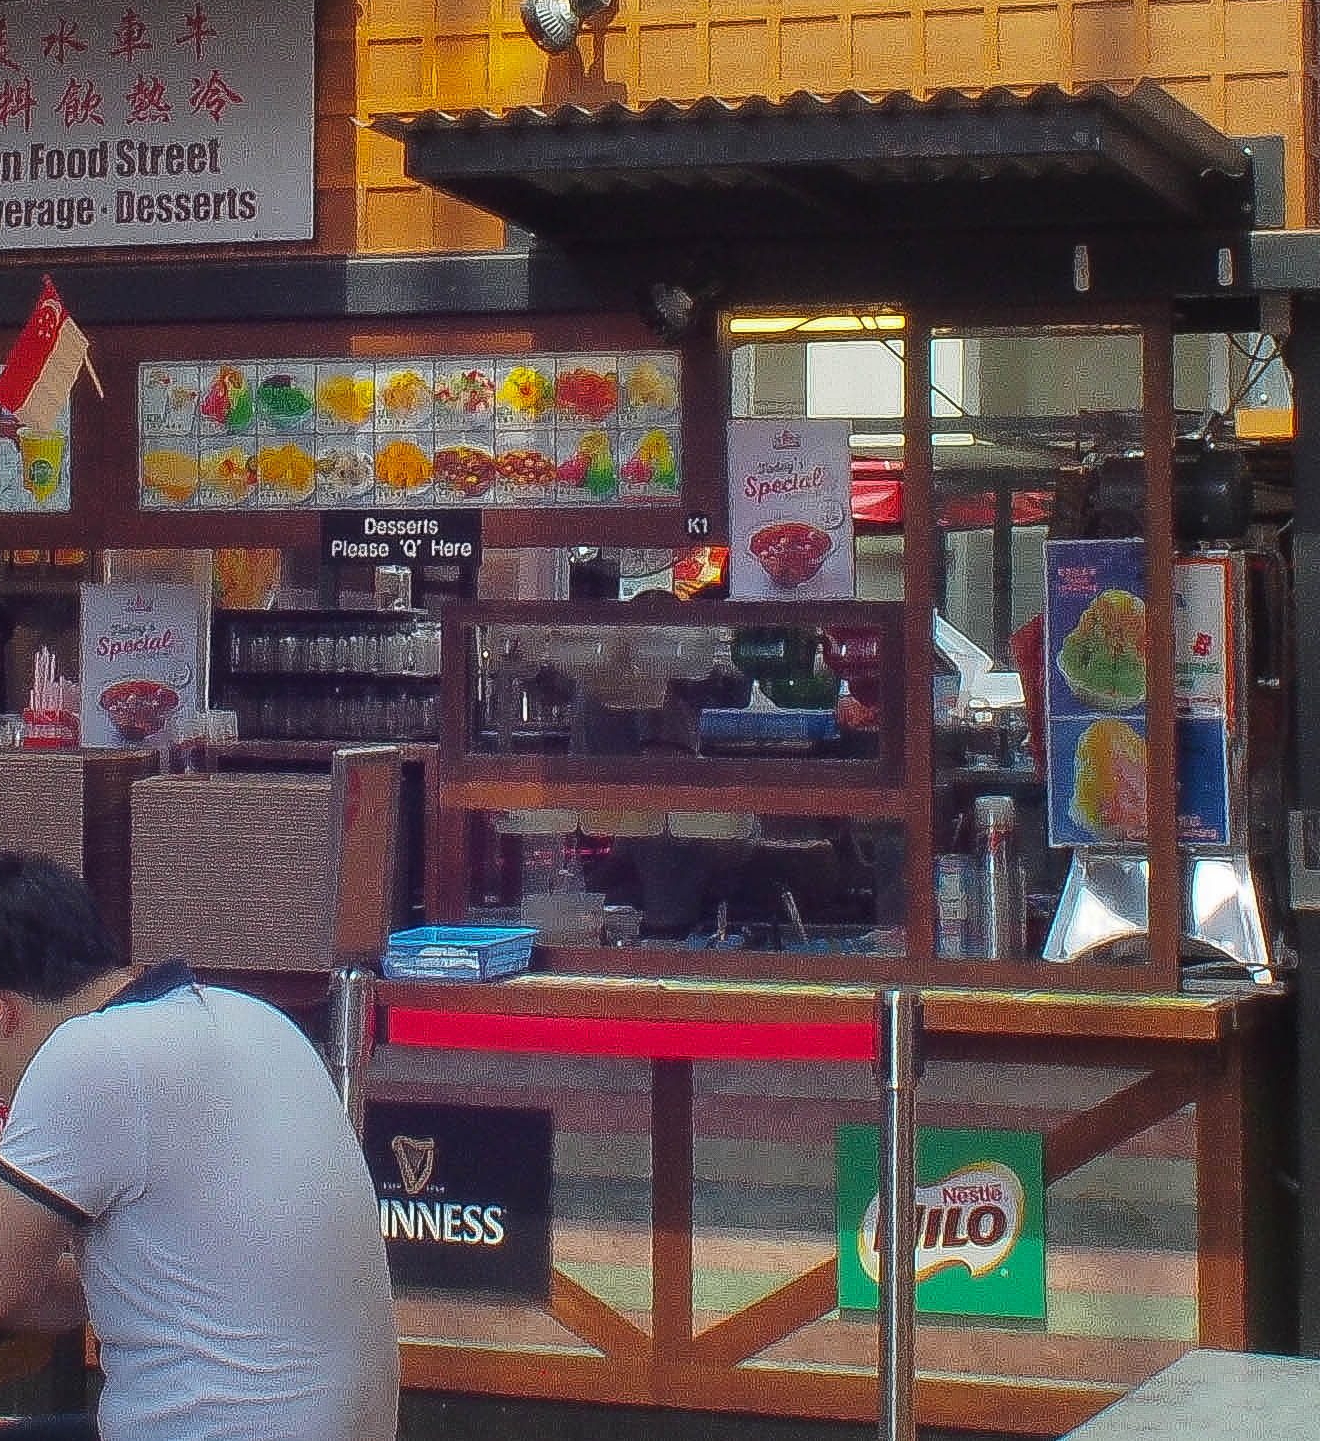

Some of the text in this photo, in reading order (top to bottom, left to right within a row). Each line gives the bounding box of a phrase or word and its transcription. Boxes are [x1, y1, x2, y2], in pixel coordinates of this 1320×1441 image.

[29, 141, 108, 182] Food
[115, 138, 222, 177] Street
[116, 187, 257, 225] Desserts
[744, 466, 826, 503] Special
[363, 517, 440, 536] Desserts
[687, 517, 708, 534] K1
[331, 540, 390, 558] Please
[431, 539, 472, 558] Here
[96, 628, 172, 661] Special
